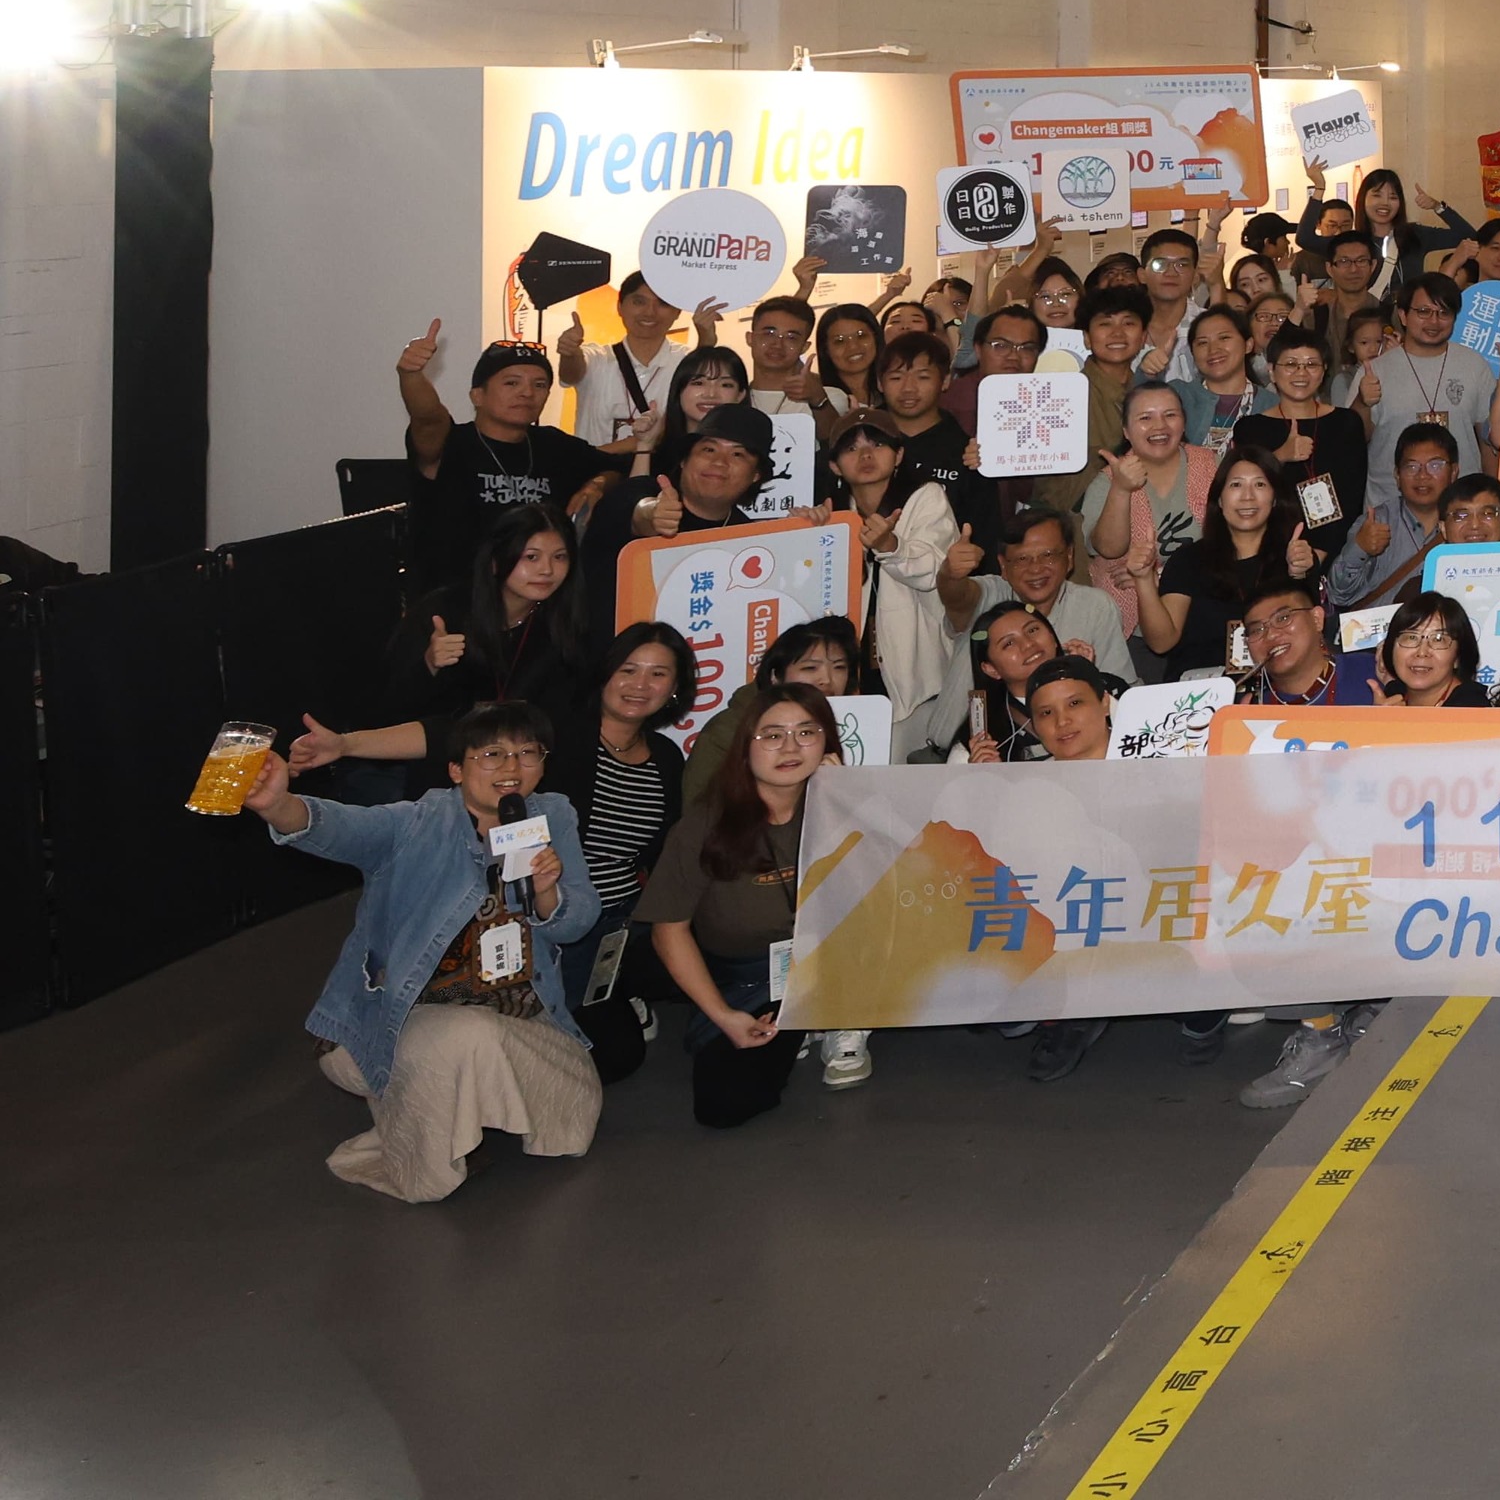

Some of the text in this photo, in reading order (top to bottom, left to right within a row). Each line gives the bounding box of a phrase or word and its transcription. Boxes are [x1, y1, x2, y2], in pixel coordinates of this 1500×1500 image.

[1014, 122, 1119, 138] Changemaker組
[1302, 111, 1360, 139] Flavor
[517, 110, 866, 200] Dream Idea
[1080, 211, 1123, 222] tshenn
[681, 260, 738, 271] Market Express
[965, 857, 1372, 953] 青年居久屋
[1088, 1324, 1242, 1498] 小心高台
